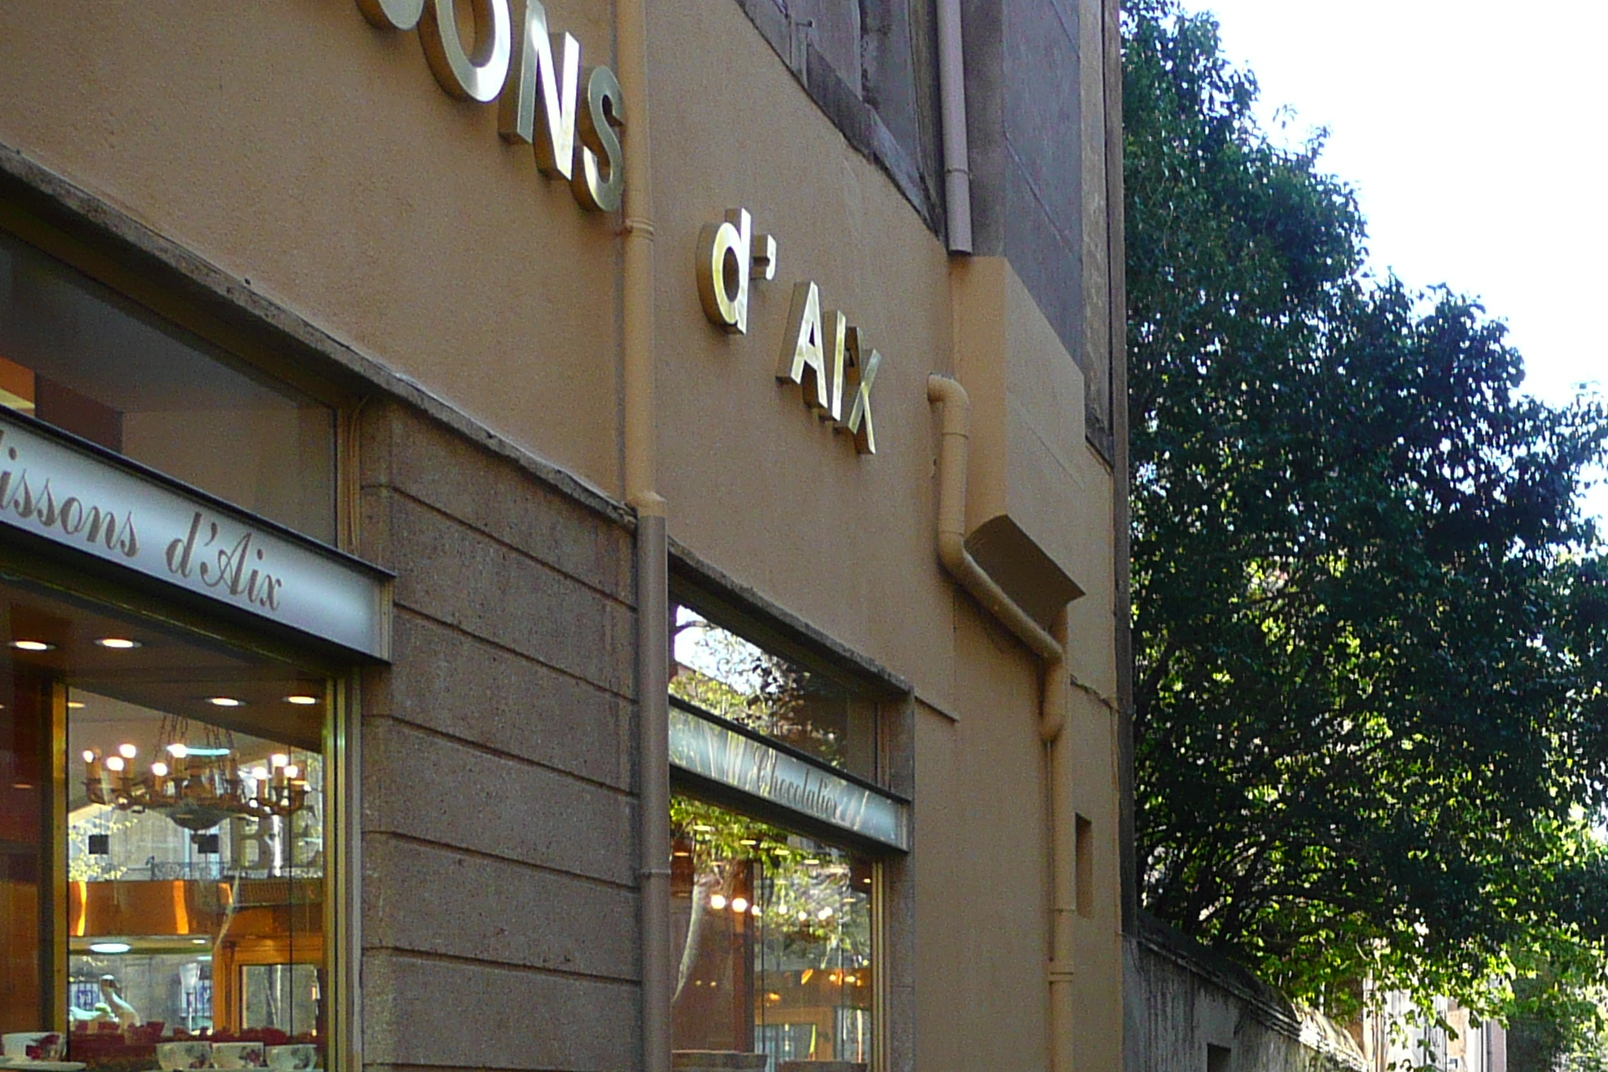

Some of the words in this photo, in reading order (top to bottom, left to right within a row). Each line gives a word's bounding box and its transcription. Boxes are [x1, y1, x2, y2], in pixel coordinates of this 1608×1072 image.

[358, 0, 626, 212] ONS
[0, 430, 139, 558] issons
[166, 511, 282, 611] d'Aix
[754, 744, 840, 821] Chocolatier
